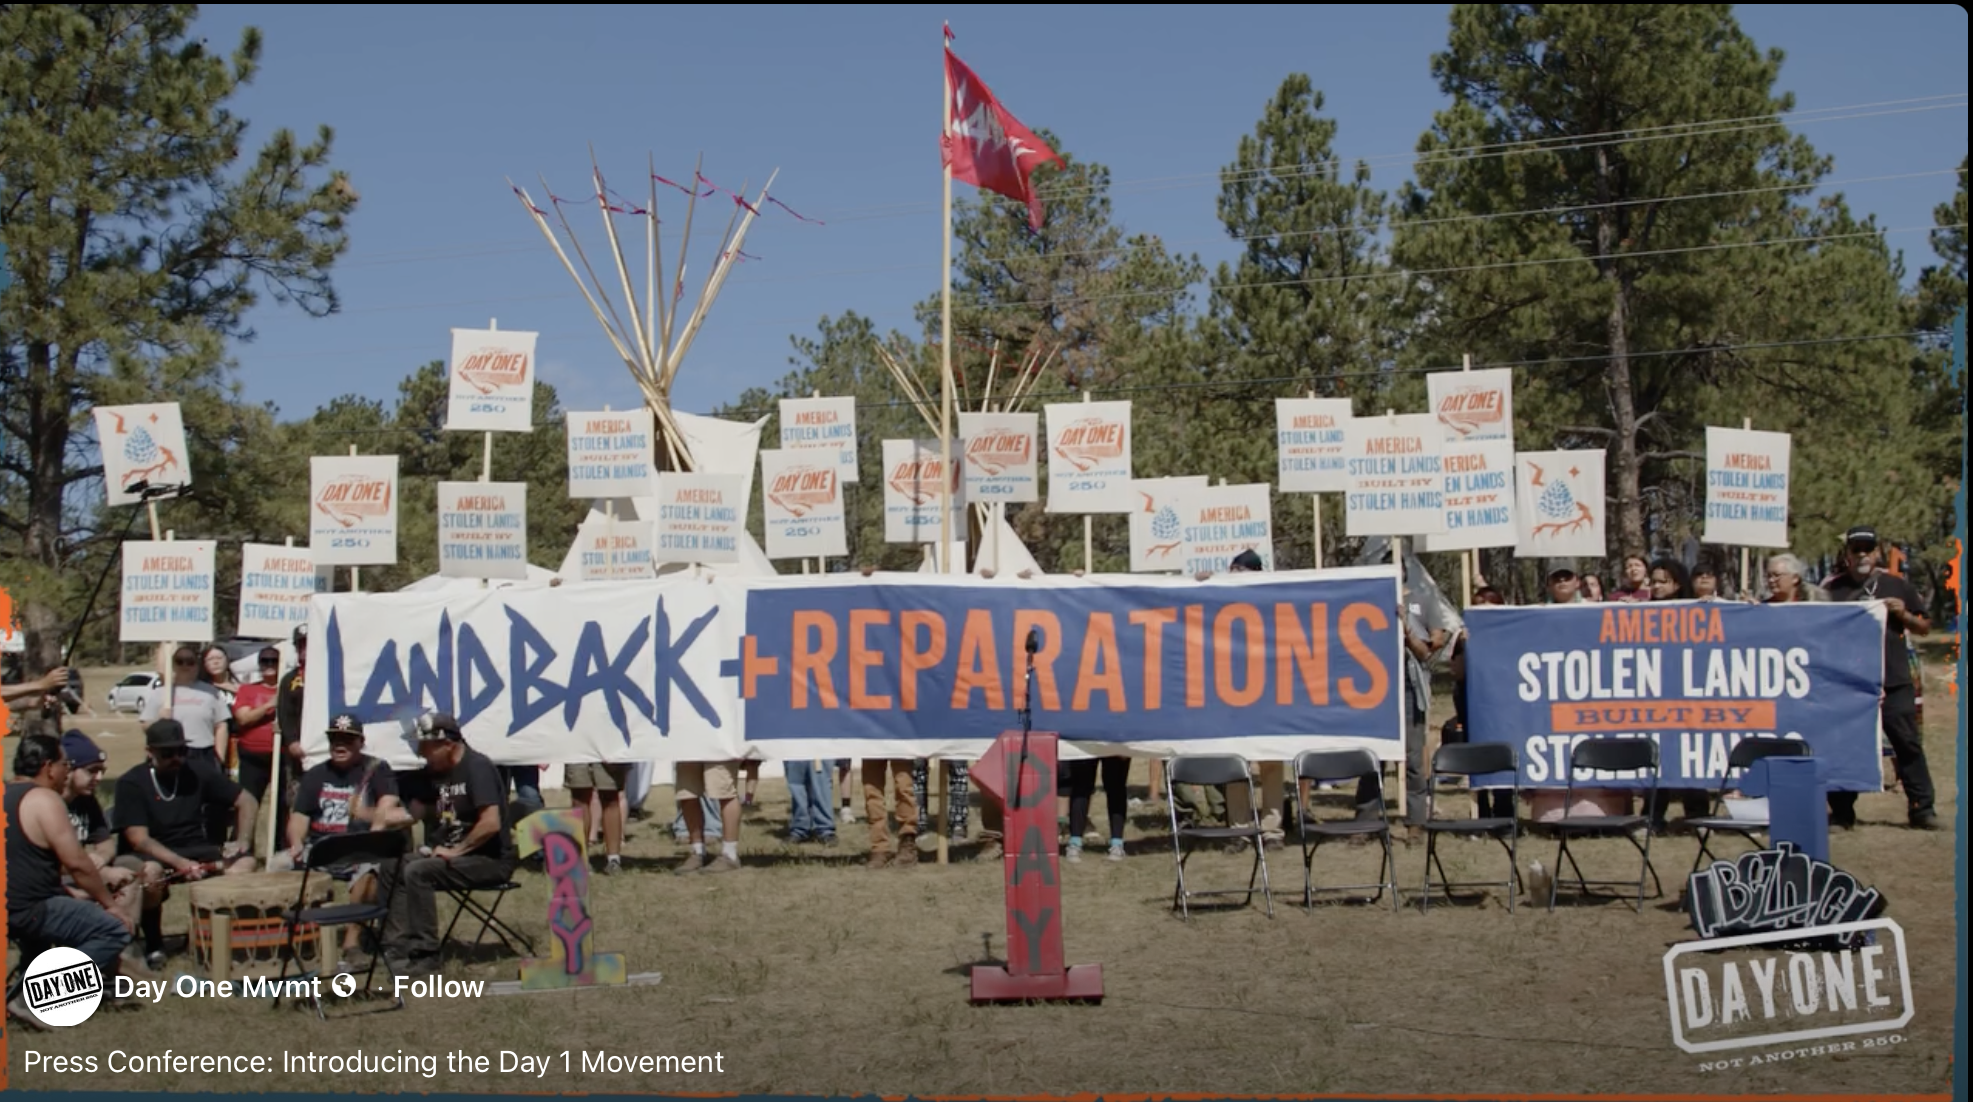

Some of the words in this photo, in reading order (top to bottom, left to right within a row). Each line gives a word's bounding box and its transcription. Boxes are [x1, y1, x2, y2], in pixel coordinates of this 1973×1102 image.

[464, 355, 492, 370] DAY
[491, 354, 522, 371] ONE
[470, 404, 506, 413] 250
[1442, 394, 1468, 411] DAY
[1467, 390, 1498, 410] ONE
[795, 410, 838, 424] AMERICA
[1293, 414, 1335, 428] AMERICA
[585, 419, 632, 434] AMERICA
[783, 427, 819, 441] STOLEN
[822, 424, 852, 439] LANDS
[1060, 426, 1087, 446] DAY
[1086, 423, 1118, 444] ONE
[572, 436, 610, 450] STOLEN
[614, 434, 646, 450] LANDS
[970, 437, 997, 453] DAY
[995, 434, 1025, 452] ONE
[1281, 430, 1316, 445] STOLEN
[1319, 430, 1344, 443] LAND
[1366, 436, 1422, 455] AMERICA
[894, 462, 922, 480] DAY
[923, 460, 950, 479] ON
[1282, 458, 1316, 471] STOLEN
[1348, 457, 1396, 475] STOLEN
[1401, 455, 1441, 474] LANDS
[1724, 453, 1772, 470] AMERICA
[572, 465, 610, 479] STOLEN
[613, 464, 647, 479] HANDS
[1708, 470, 1750, 488] STOLEN
[1753, 473, 1786, 490] LANDS
[773, 473, 801, 492] DAY
[800, 470, 830, 490] ONE
[980, 485, 1014, 494] 250
[1069, 481, 1106, 491] 250
[1358, 479, 1408, 488] BUILT
[1410, 477, 1433, 487] BY
[1465, 472, 1506, 491] LANDS
[323, 483, 352, 501] DAY
[352, 481, 384, 500] ONE
[675, 489, 723, 504] AMERICA
[1476, 494, 1498, 504] BY
[457, 495, 505, 511] AMERICA
[1349, 492, 1396, 510] STOLEN
[1401, 491, 1442, 510] HANDS
[443, 513, 483, 528] STOLEN
[487, 513, 521, 528] LANDS
[661, 505, 700, 520] STOLEN
[704, 506, 737, 521] LANDS
[905, 516, 942, 525] 250
[1200, 505, 1251, 523] AMERICA
[1467, 506, 1509, 527] HANDS
[1708, 502, 1749, 519] STOLEN
[1751, 505, 1786, 522] HANDS
[785, 527, 820, 537] 250
[1185, 525, 1228, 542] STOLEN
[1231, 521, 1267, 539] LANDS
[331, 538, 370, 548] 250
[661, 534, 699, 549] STOLEN
[702, 535, 737, 551] HANDS
[443, 545, 483, 559] STOLEN
[487, 545, 522, 559] HANDS
[621, 550, 650, 563] LANDS
[142, 556, 194, 572] AMERICA
[263, 557, 313, 573] AMERICA
[126, 574, 169, 591] STOLEN
[173, 574, 210, 590] LANDS
[246, 573, 289, 588] STOLEN
[125, 606, 167, 622] STOLEN
[171, 606, 209, 622] HANDS
[244, 603, 286, 620] STOLEN
[1599, 607, 1724, 643] AMERICA
[791, 602, 1390, 711] REPARATIONS
[1518, 648, 1662, 702] STOLEN
[1682, 646, 1811, 699] LANDS
[1574, 708, 1693, 726] BUILT
[1701, 706, 1753, 725] BY
[1006, 751, 1055, 973] DAY
[542, 832, 592, 975] DAY
